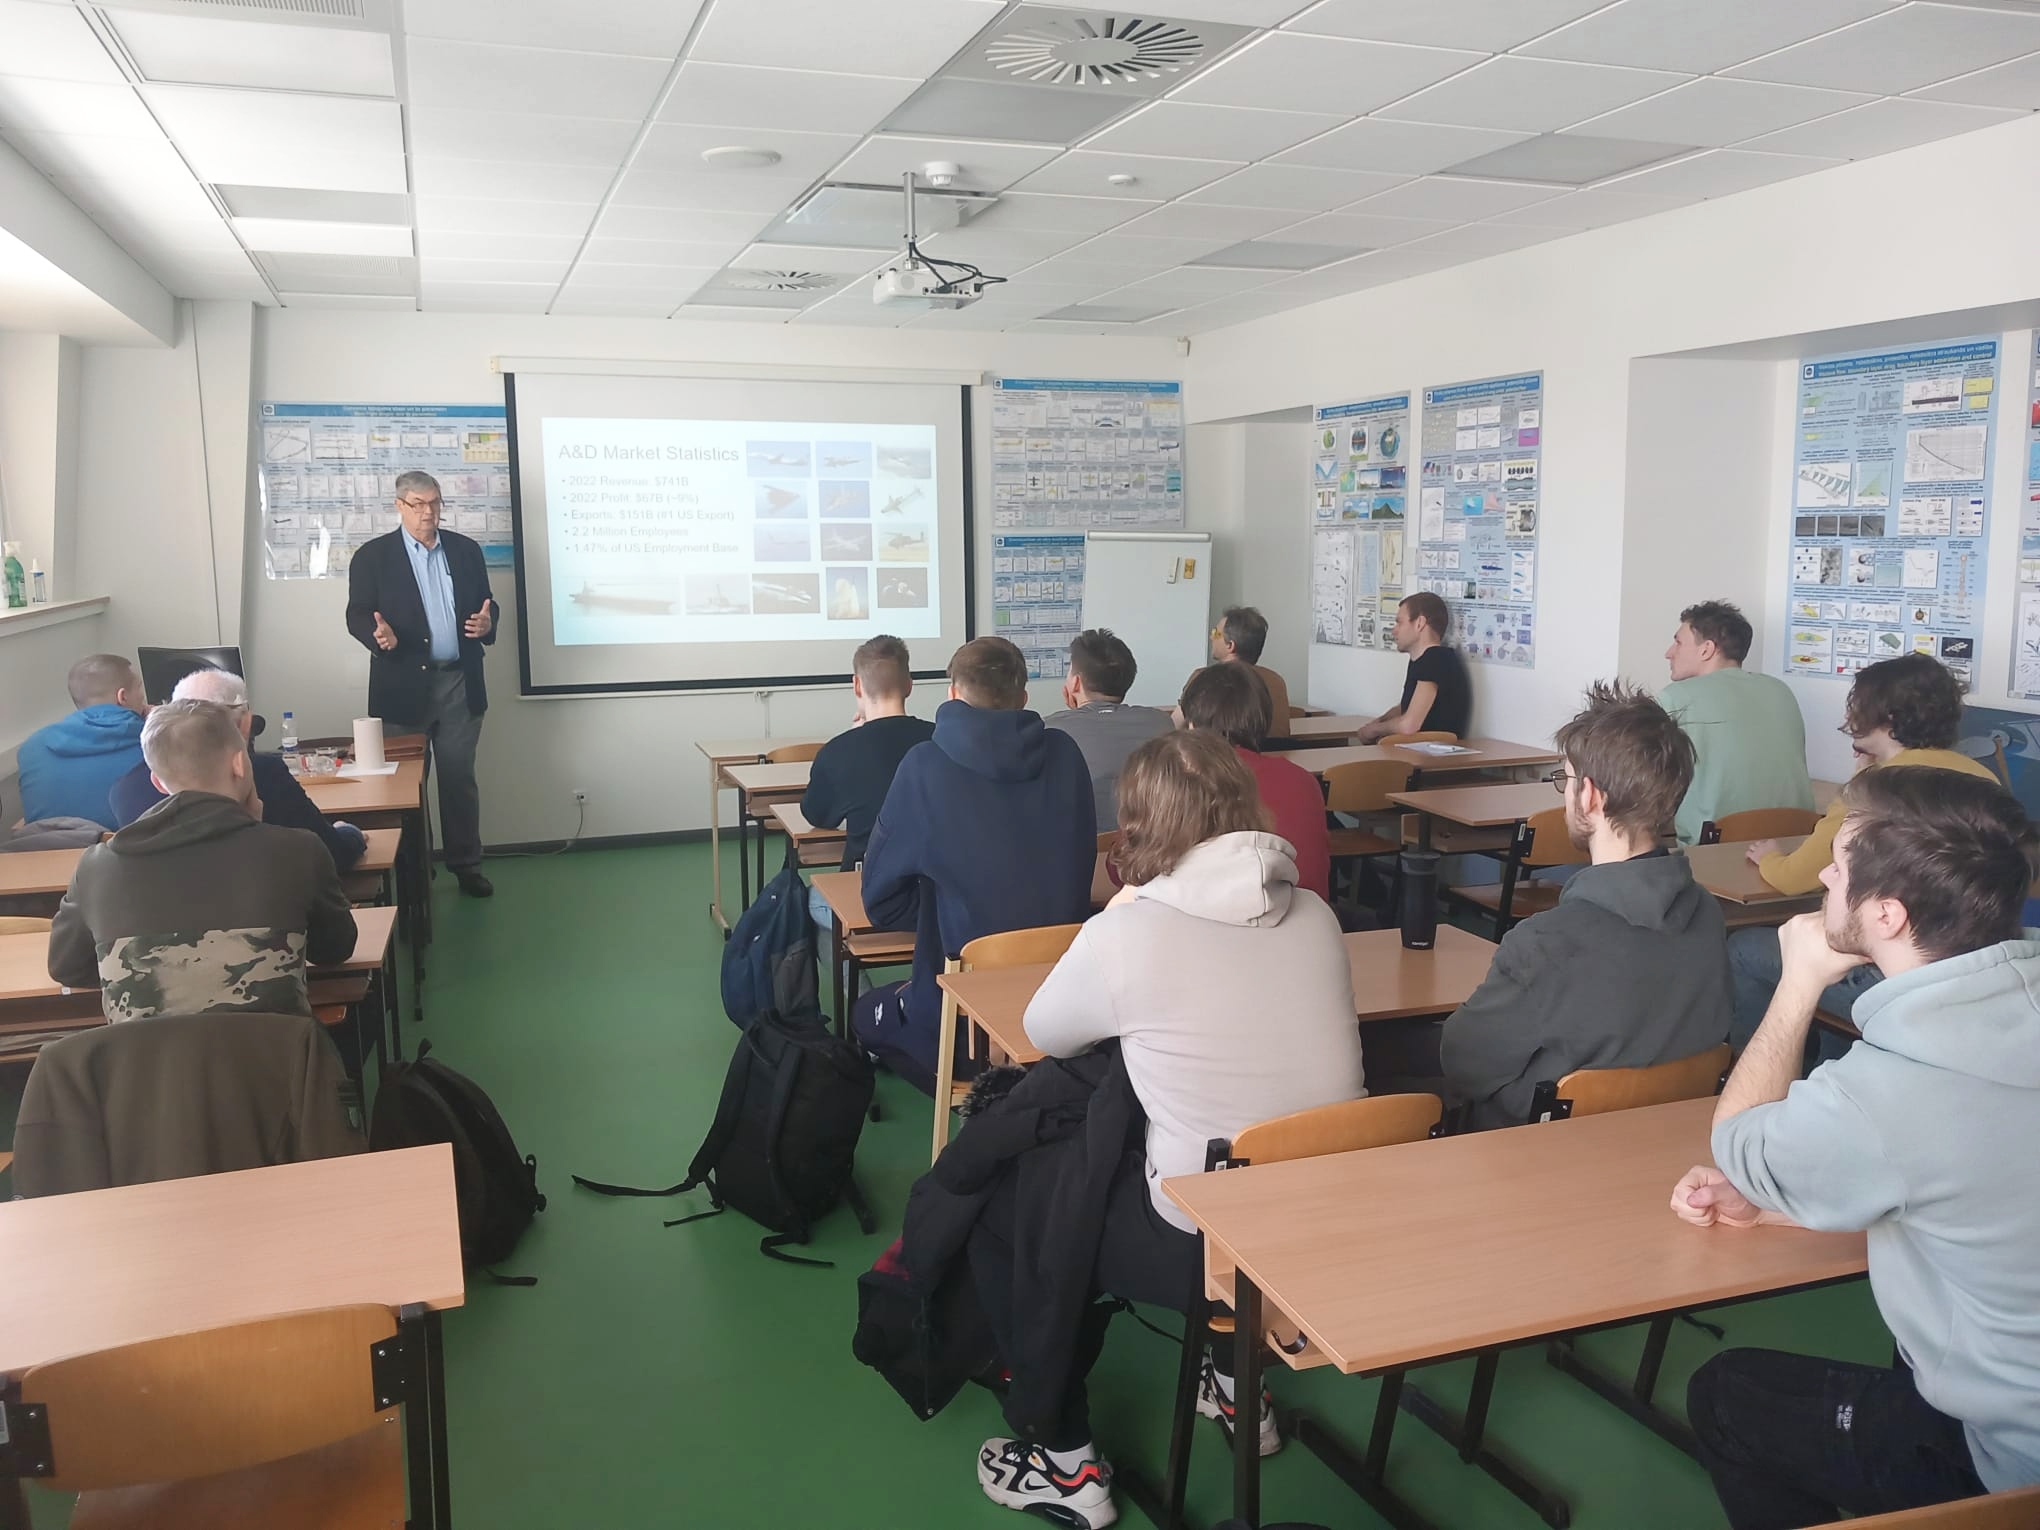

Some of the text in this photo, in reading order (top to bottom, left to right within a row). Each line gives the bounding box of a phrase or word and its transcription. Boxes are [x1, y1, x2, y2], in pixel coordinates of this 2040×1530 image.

[558, 444, 740, 461] A&D Market Statistics
[568, 475, 597, 487] 2022
[654, 476, 689, 487] $741B
[569, 492, 598, 504] 2022
[618, 510, 654, 521] $151B
[677, 510, 694, 520] US
[696, 510, 735, 522] Export)
[592, 527, 627, 537] Million
[630, 527, 689, 539] Employees
[610, 543, 623, 553] of
[625, 543, 642, 553] US
[644, 543, 709, 555] Employment
[712, 543, 739, 554] Base
